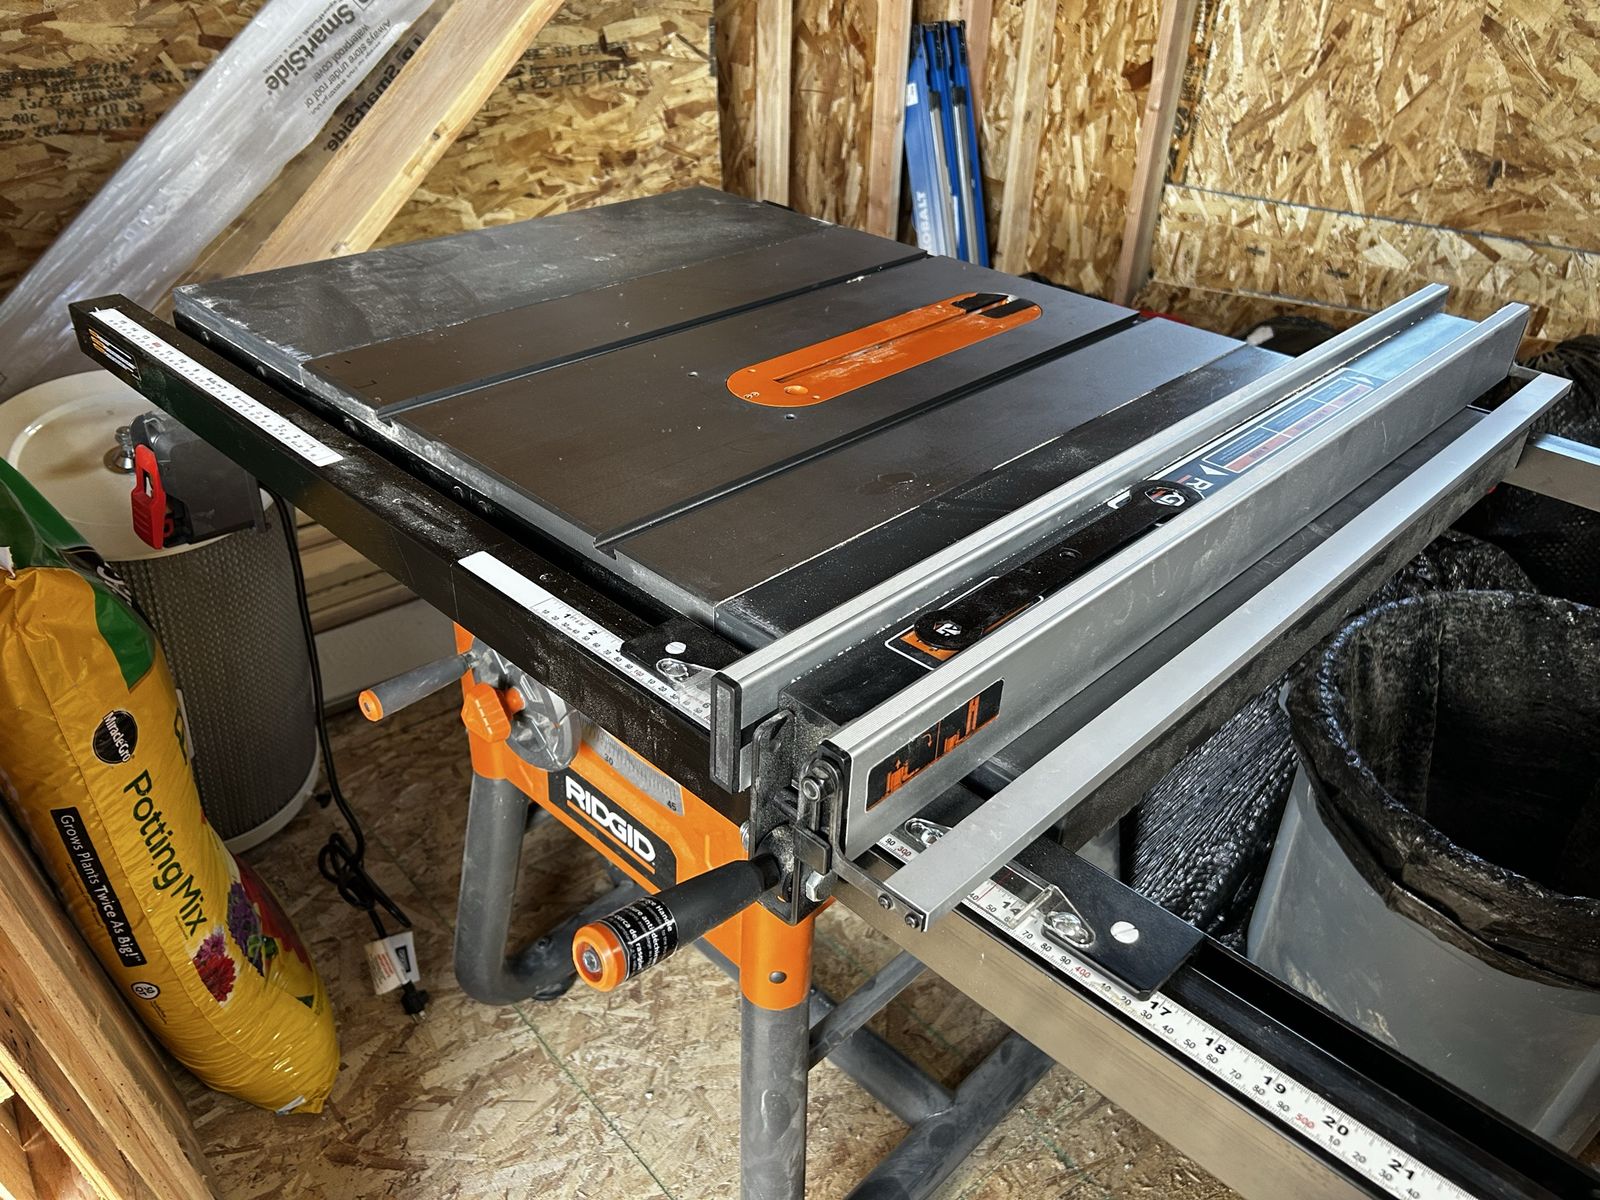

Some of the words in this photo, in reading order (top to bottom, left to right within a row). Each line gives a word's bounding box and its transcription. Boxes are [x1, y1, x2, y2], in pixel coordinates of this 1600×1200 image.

[265, 4, 355, 91] SmartSide
[312, 60, 333, 83] cover
[328, 61, 349, 85] under
[332, 24, 370, 64] waterproof
[348, 43, 367, 64] store
[312, 81, 329, 102] roof
[124, 769, 184, 891] Potting
[565, 775, 656, 863] RIDGID
[667, 800, 677, 812] 45
[60, 814, 84, 851] Grows
[77, 851, 100, 884] Plants
[94, 885, 117, 918] Twice
[110, 919, 125, 934] As
[171, 874, 208, 937] Mix
[985, 904, 997, 913] 50
[1022, 930, 1034, 940] 70
[1040, 942, 1052, 952] 80
[1060, 955, 1072, 965] 90
[1075, 966, 1091, 979] 400
[1101, 983, 1112, 992] 10
[1120, 995, 1131, 1006] 20
[1140, 1009, 1153, 1020] 30
[1162, 1024, 1174, 1035] 40
[1183, 1038, 1196, 1049] 50
[1206, 1053, 1218, 1064] 60
[1229, 1068, 1242, 1080] 70
[1252, 1084, 1265, 1096] 80
[1276, 1100, 1290, 1112] 90
[1295, 1112, 1315, 1129] 500
[1328, 1135, 1341, 1147] 10
[1352, 1151, 1367, 1164] 20
[1378, 1168, 1393, 1181] 30
[1405, 1188, 1420, 1199] 40
[1002, 901, 1022, 916] 14
[1150, 1000, 1172, 1017] 17
[1205, 1036, 1227, 1056] 18
[1263, 1075, 1287, 1095] 19
[1322, 1115, 1349, 1137] 20
[1388, 1158, 1415, 1180] 21
